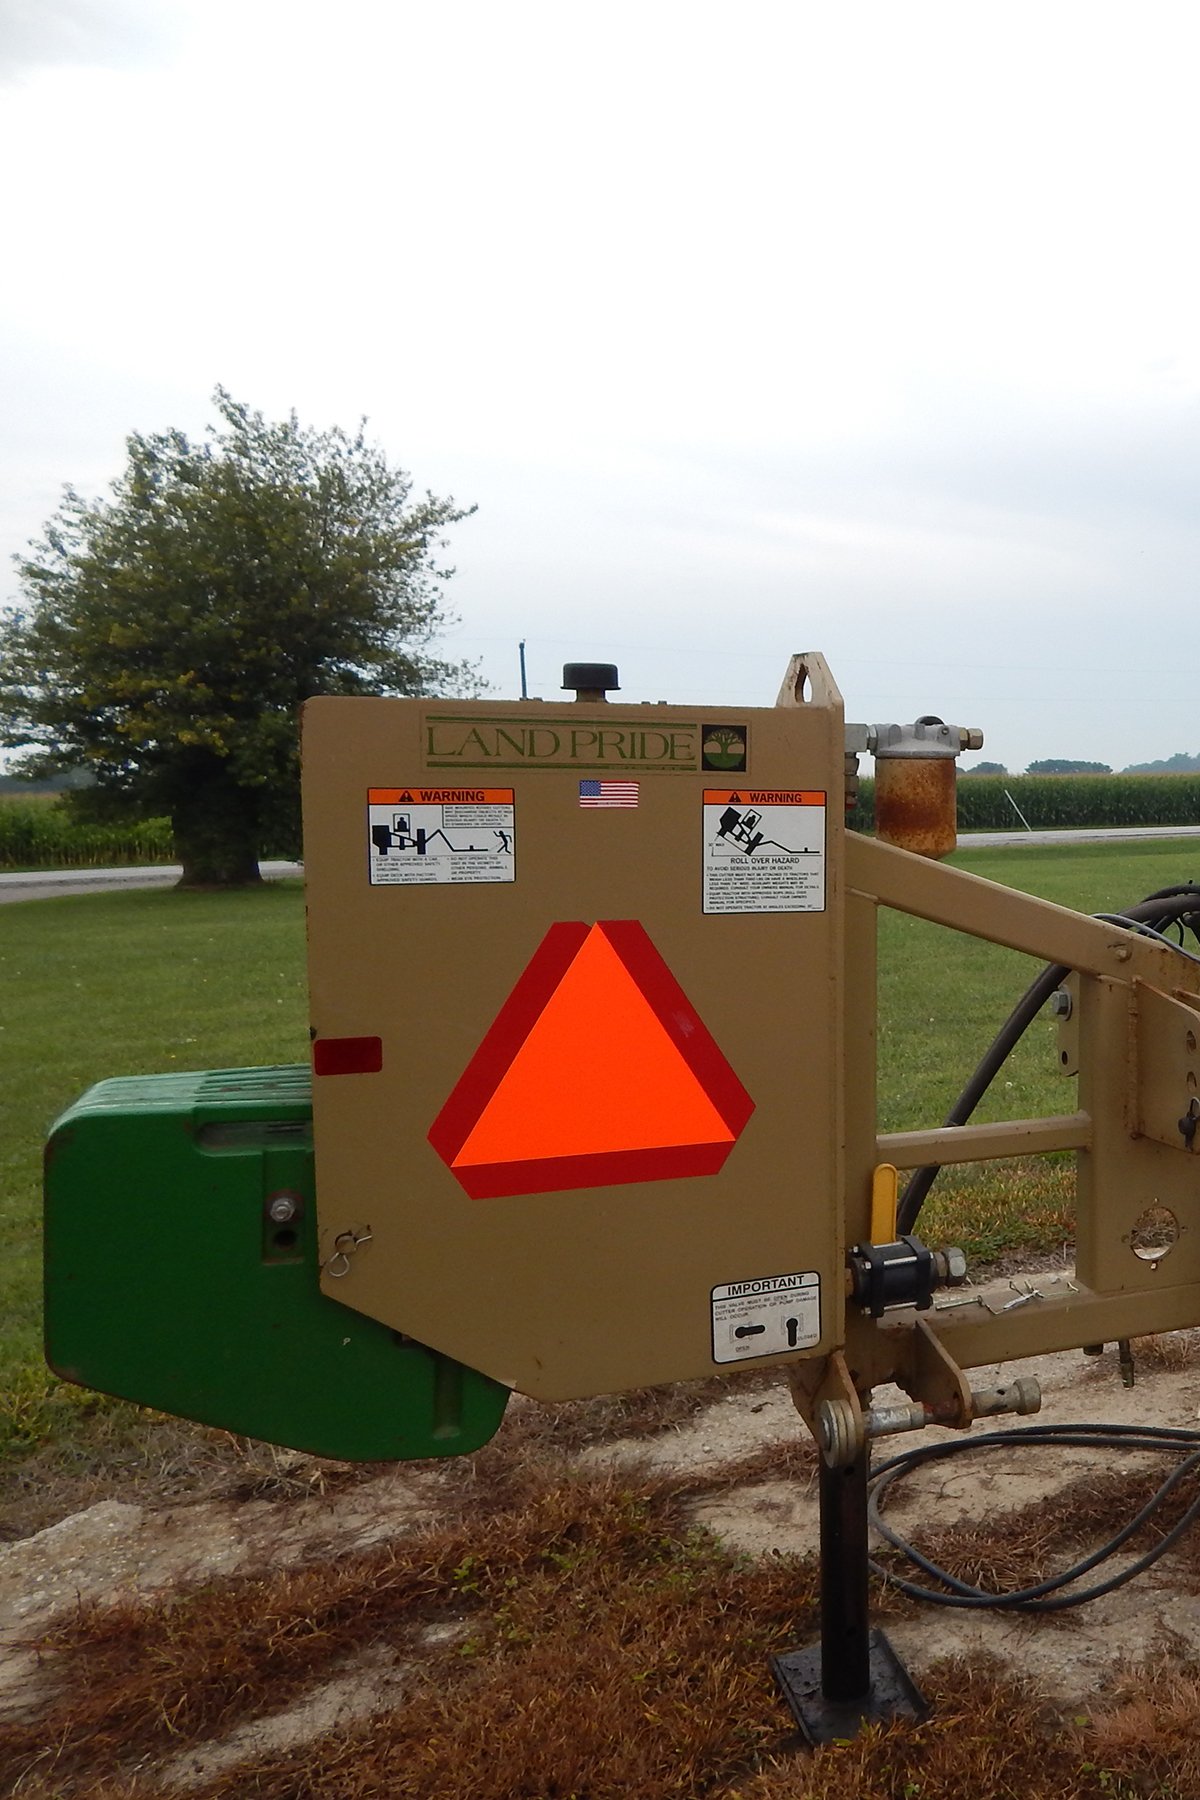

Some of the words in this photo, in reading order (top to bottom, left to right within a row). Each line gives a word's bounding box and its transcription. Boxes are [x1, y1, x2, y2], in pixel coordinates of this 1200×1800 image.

[427, 726, 561, 758] LAND
[571, 730, 697, 761] PRIDE
[420, 791, 485, 802] WARNING
[750, 794, 802, 803] WARNING
[728, 1275, 805, 1296] IMPORTANT
